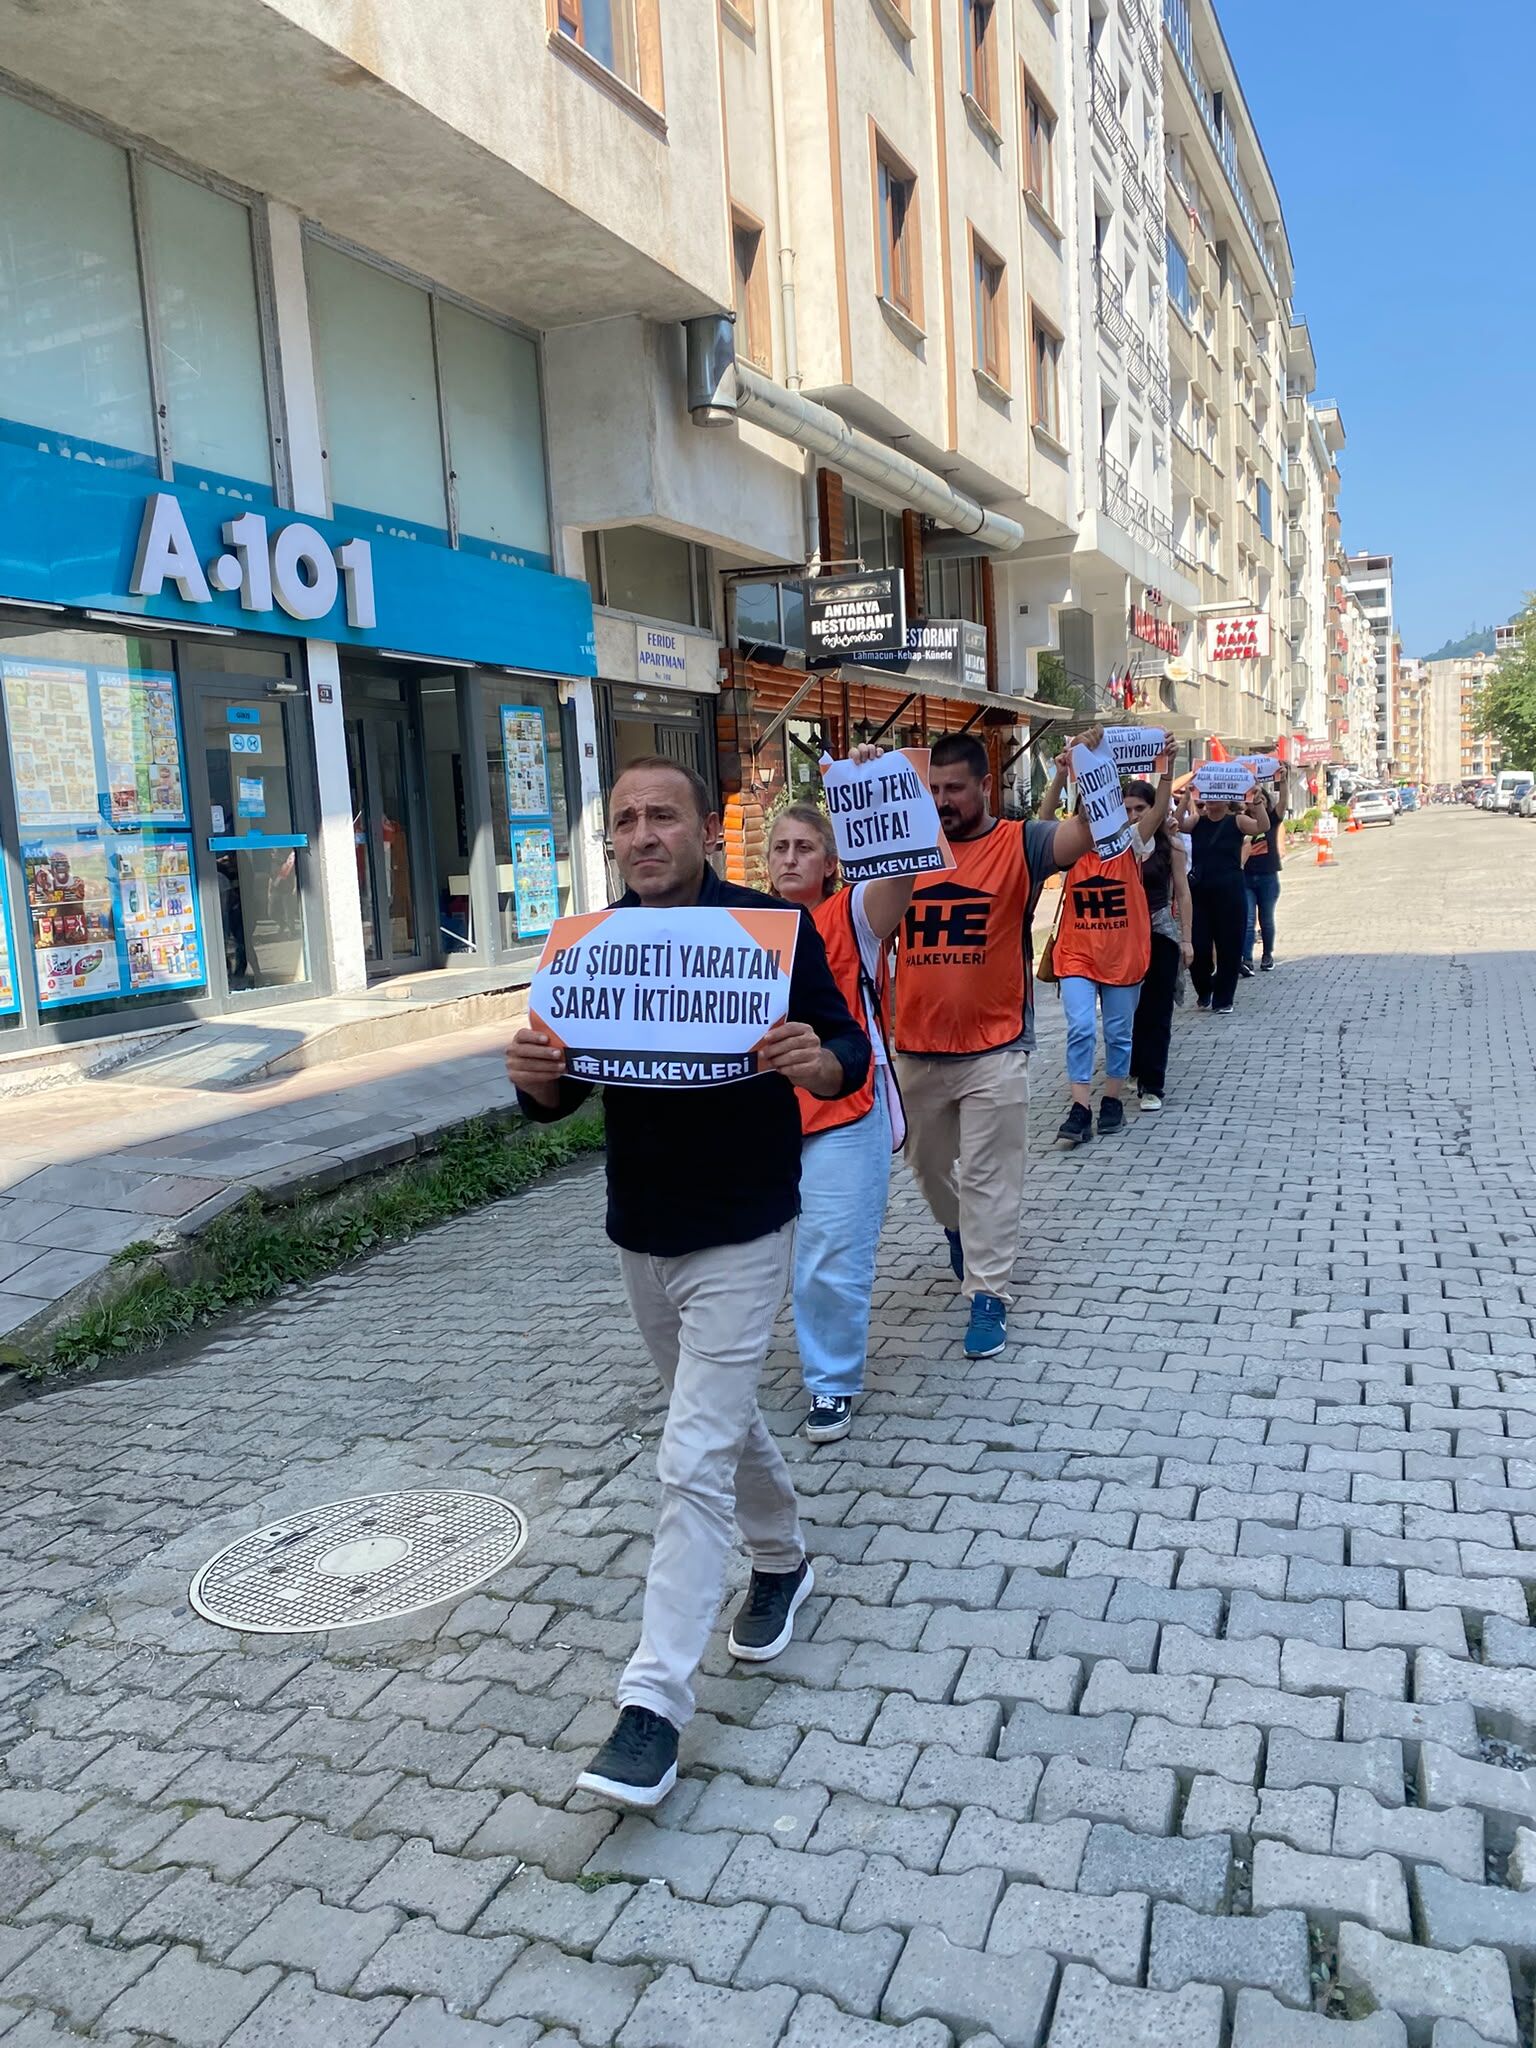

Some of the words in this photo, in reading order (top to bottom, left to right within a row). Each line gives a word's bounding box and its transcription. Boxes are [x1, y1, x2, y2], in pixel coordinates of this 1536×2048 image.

[825, 600, 880, 618] ANTAKYA
[811, 613, 895, 635] RESTORANT
[904, 627, 959, 648] ESTORANT
[1216, 632, 1258, 647] NANA
[639, 650, 685, 670] APARTMANI
[1213, 646, 1262, 661] HOTEL
[827, 780, 872, 814] USUF
[846, 810, 910, 849] İSTİFA!
[846, 850, 942, 879] HALKEVLERİ
[1074, 918, 1129, 931] HALKEVLERİ
[550, 946, 581, 976] BU
[586, 940, 671, 981] ŞİDDETİ
[679, 944, 782, 981] YARATAN
[551, 985, 625, 1021] SARAY
[633, 983, 770, 1025] İKTİDARIDIR!
[603, 1056, 750, 1081] HALKEVLERİ
